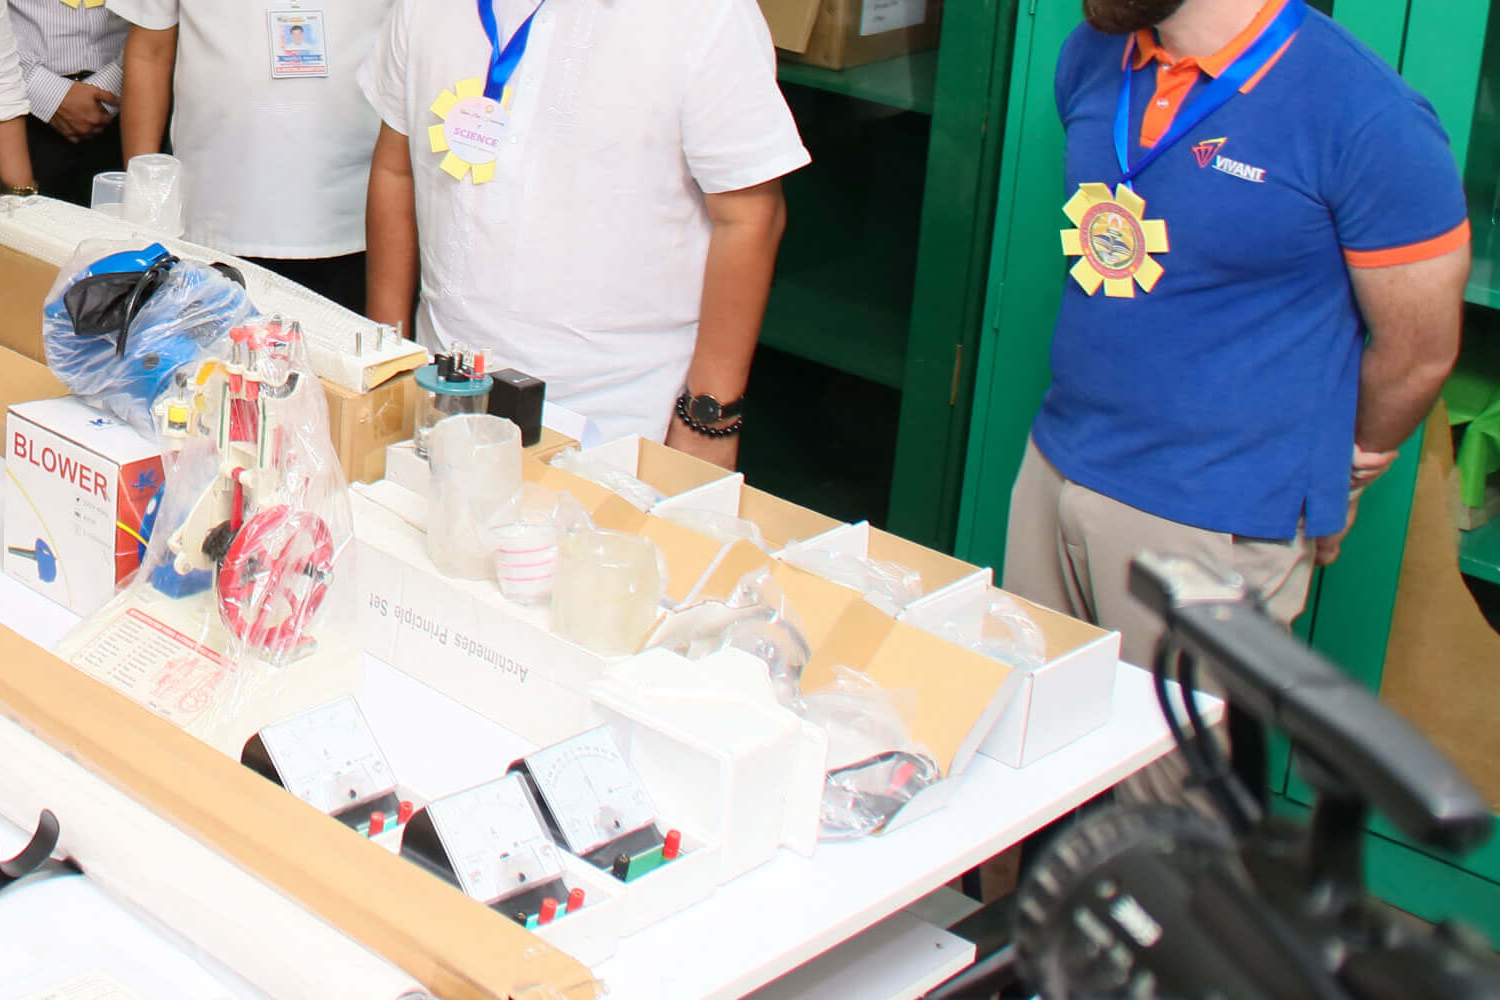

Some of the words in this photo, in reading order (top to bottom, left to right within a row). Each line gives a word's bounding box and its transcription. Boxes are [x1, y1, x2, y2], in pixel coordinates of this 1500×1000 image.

[453, 127, 499, 147] SCIENCE
[1216, 154, 1266, 181] VIVANT
[14, 431, 108, 501] BLOWER
[369, 592, 389, 617] Set
[394, 605, 449, 645] Principle
[453, 632, 529, 683] Archimedes
